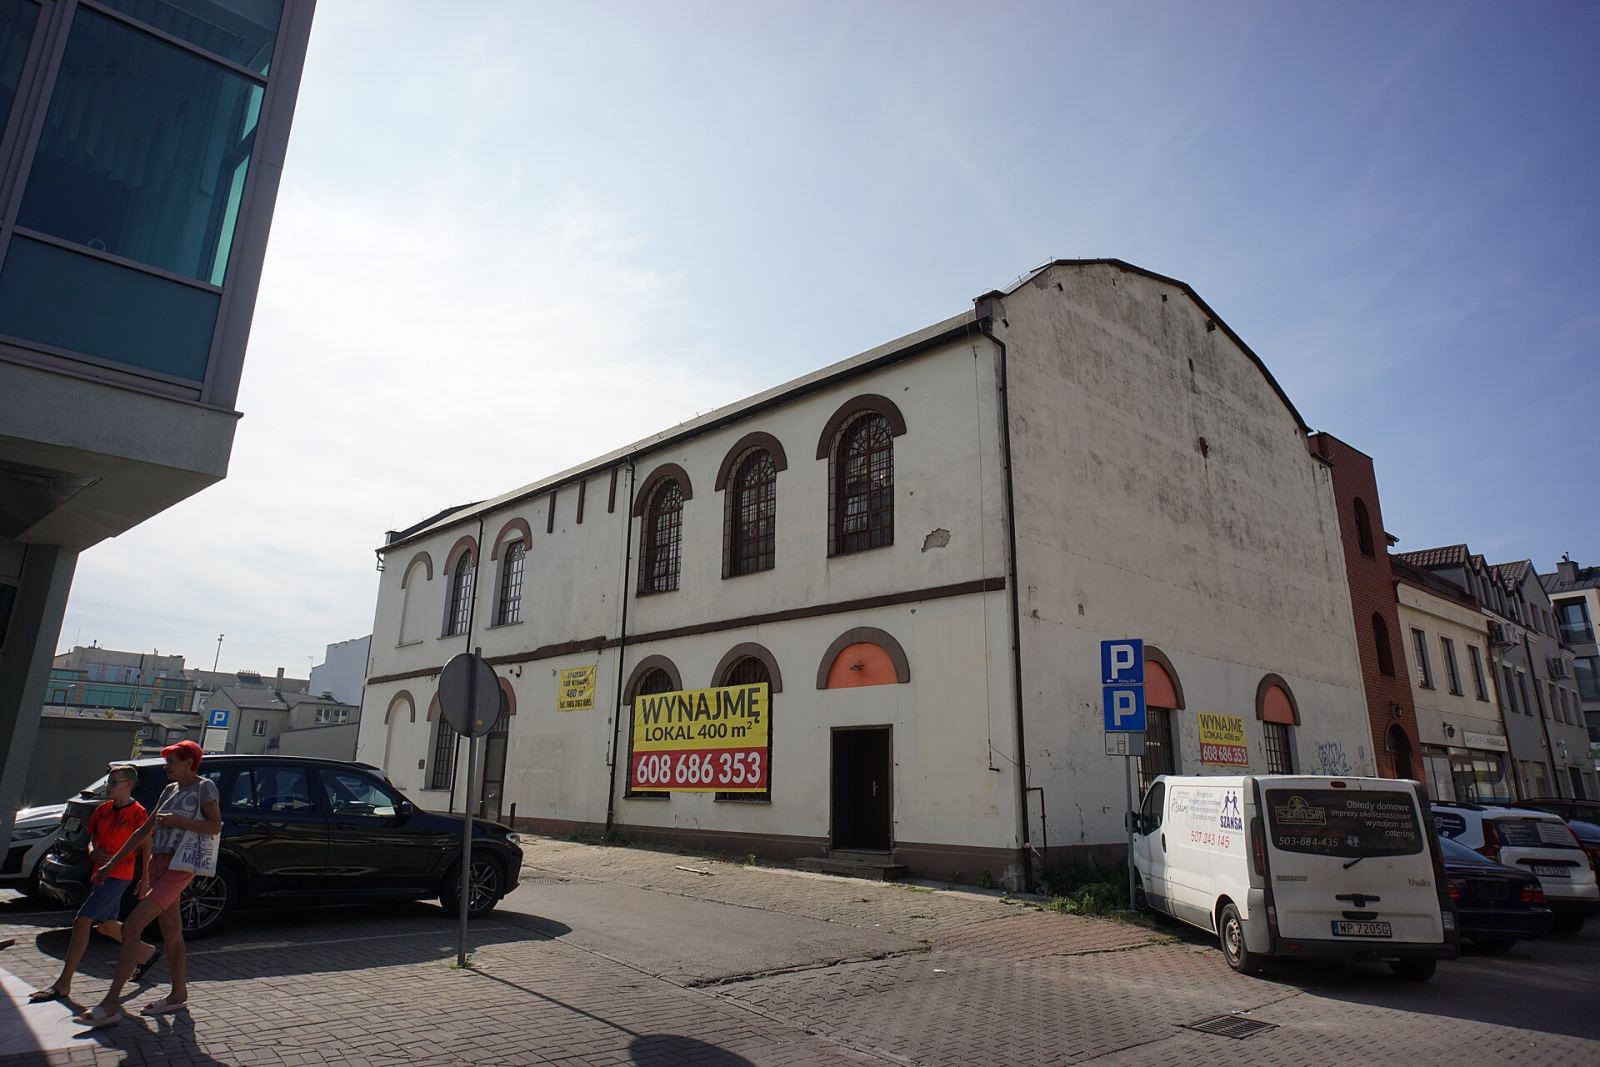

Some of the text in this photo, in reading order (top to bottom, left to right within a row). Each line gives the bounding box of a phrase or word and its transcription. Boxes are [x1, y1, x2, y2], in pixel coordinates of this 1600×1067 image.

[1110, 644, 1134, 679] P
[641, 687, 761, 725] WYNAJMĘ
[1112, 690, 1137, 726] P
[213, 711, 226, 725] P
[1200, 713, 1243, 735] WYNAJMĘ
[645, 725, 694, 742] LOKAL
[697, 723, 728, 740] 400
[1203, 730, 1224, 741] LOKAL
[1224, 732, 1234, 742] 400
[1203, 745, 1247, 763] 608 686 353
[636, 751, 761, 784] 608 686 353
[1331, 809, 1359, 819] imprezy
[1377, 801, 1410, 812] domowe
[1220, 815, 1243, 831] SZANSA
[1365, 820, 1399, 829] wynajem
[1191, 830, 1202, 843] 507
[1203, 832, 1215, 846] 243
[1217, 834, 1230, 849] 145
[1278, 836, 1339, 847] 503-684-435
[1385, 829, 1415, 840] catering
[1339, 922, 1389, 935] WP 7205G
